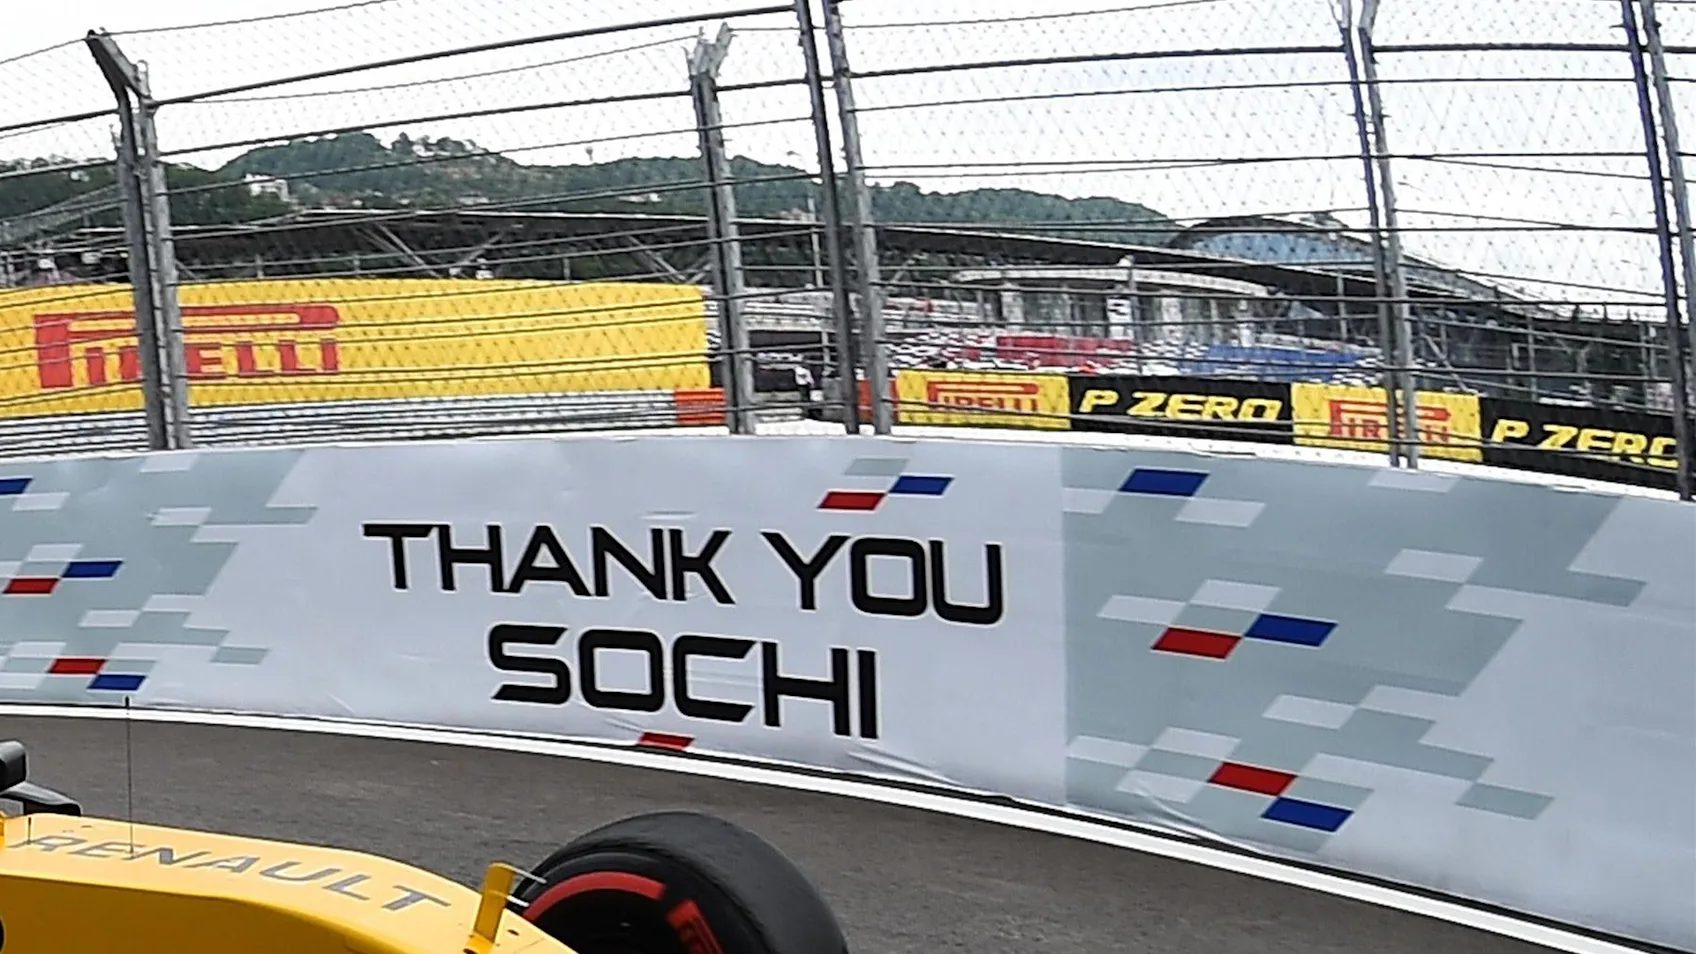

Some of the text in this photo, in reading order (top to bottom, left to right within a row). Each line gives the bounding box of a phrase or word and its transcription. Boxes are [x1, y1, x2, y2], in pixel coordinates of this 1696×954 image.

[1079, 389, 1283, 422] P ZERO
[1329, 399, 1451, 442] PIRLI
[1491, 418, 1530, 446] P
[362, 522, 1003, 625] THANK YOU
[488, 623, 879, 741] SOCHI
[8, 835, 452, 912] RENAULT
